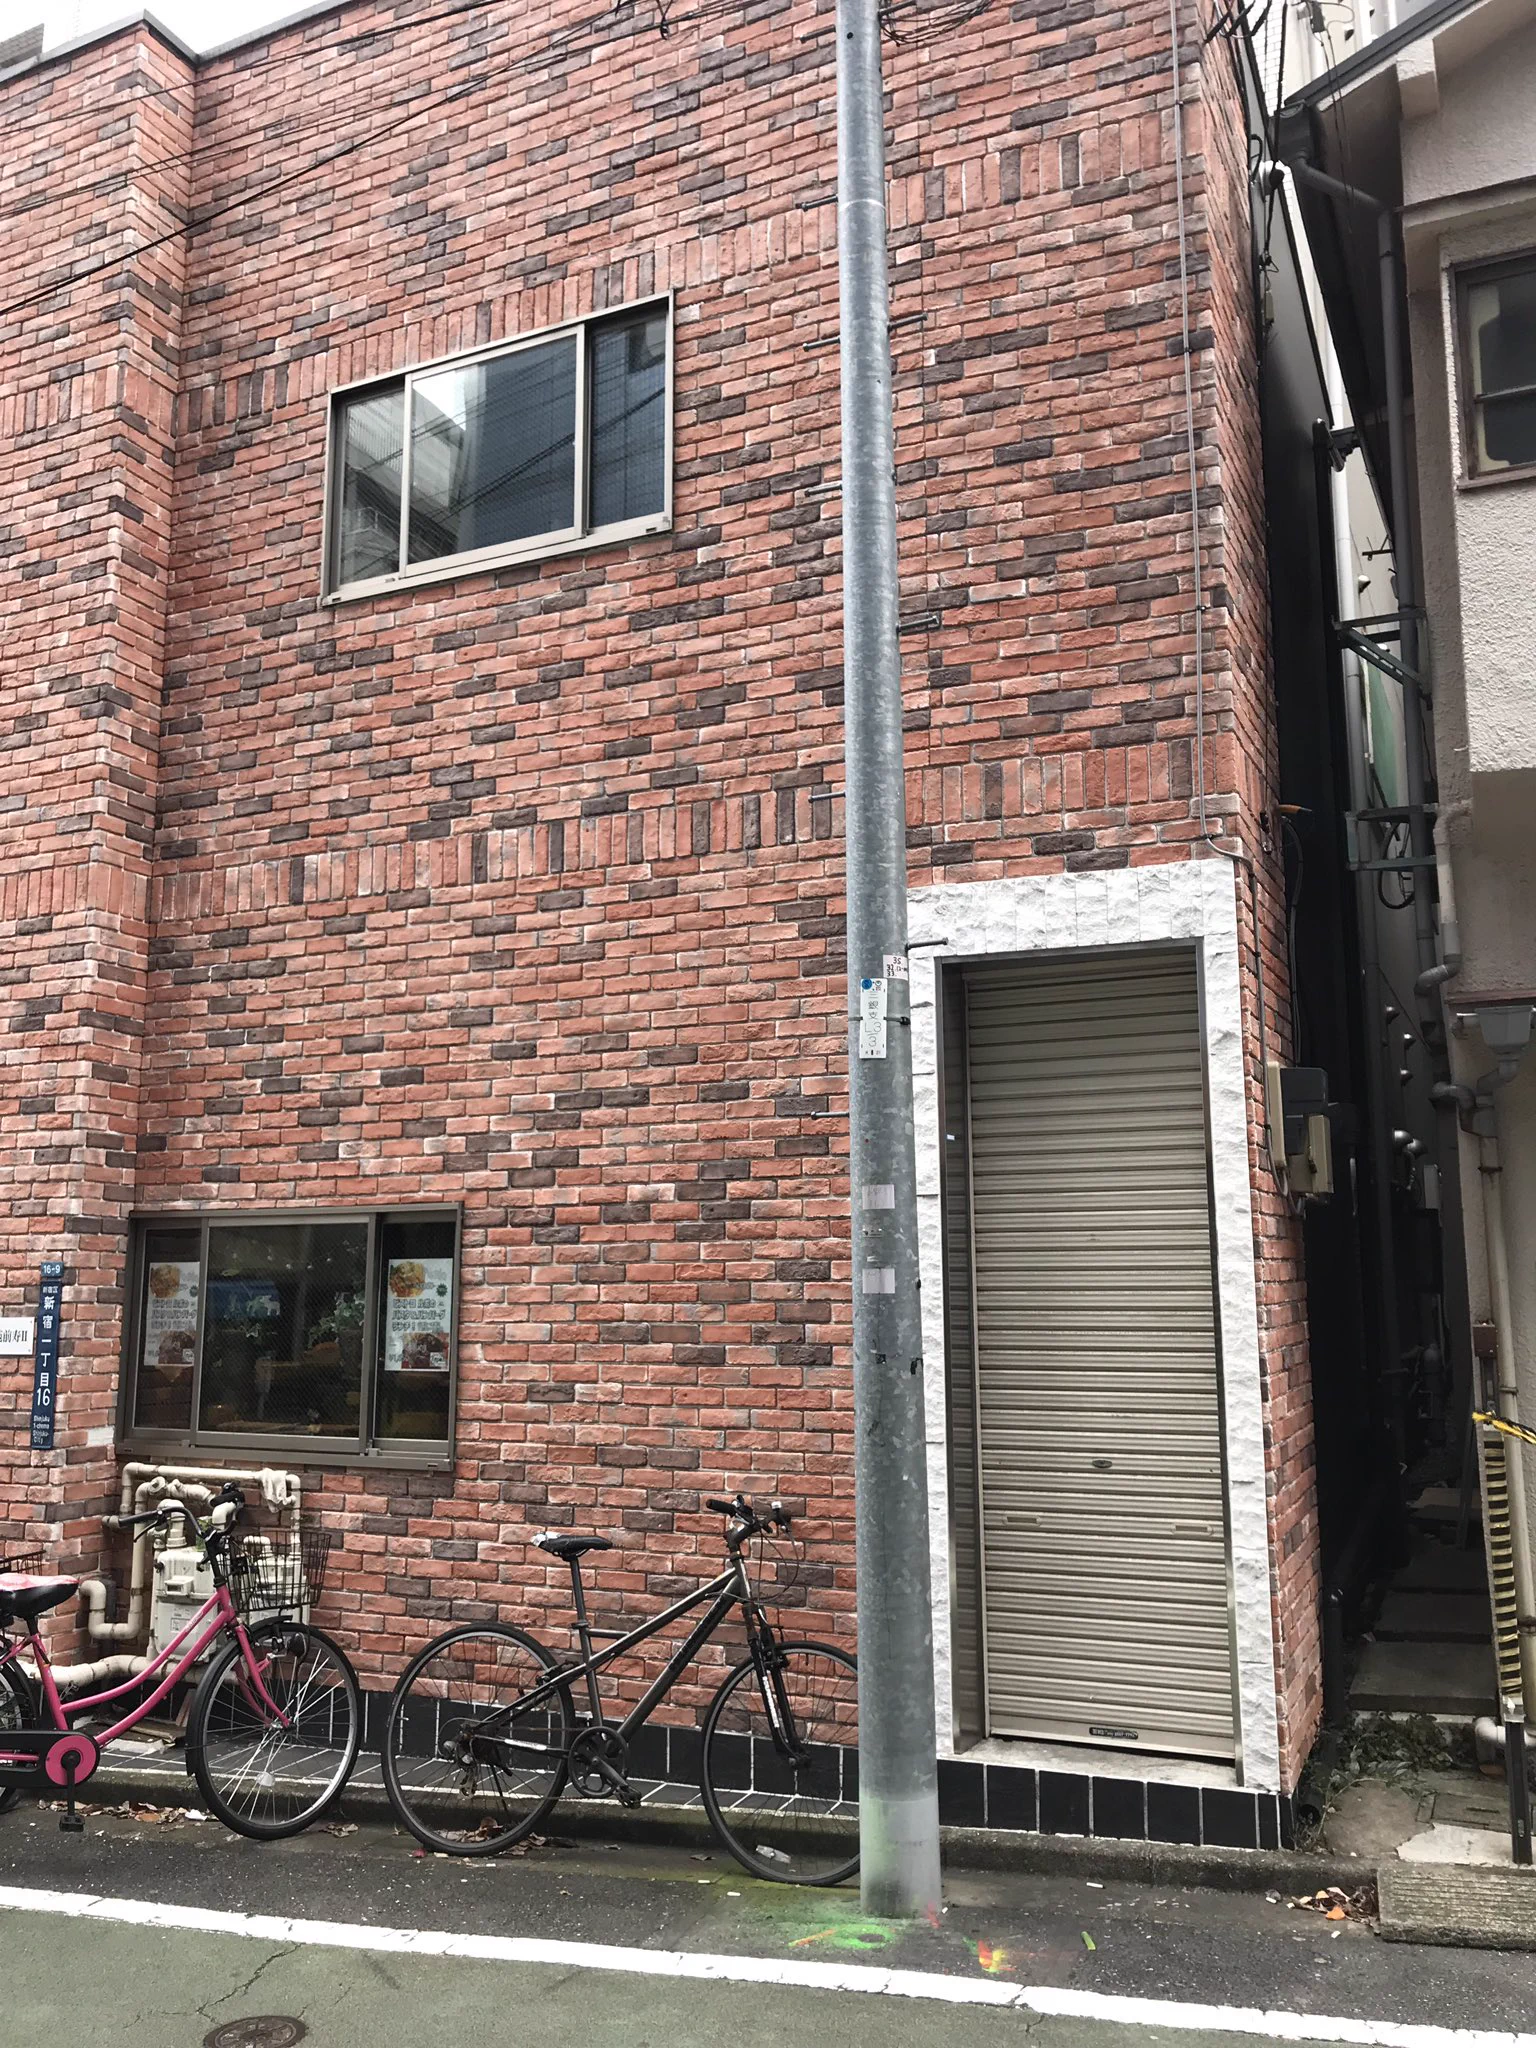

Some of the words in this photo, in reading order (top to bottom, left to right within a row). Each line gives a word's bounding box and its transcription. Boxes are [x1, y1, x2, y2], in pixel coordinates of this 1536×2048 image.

[43, 1264, 61, 1274] 16-9
[43, 1286, 59, 1294] 新宿区
[36, 1388, 51, 1406] 16
